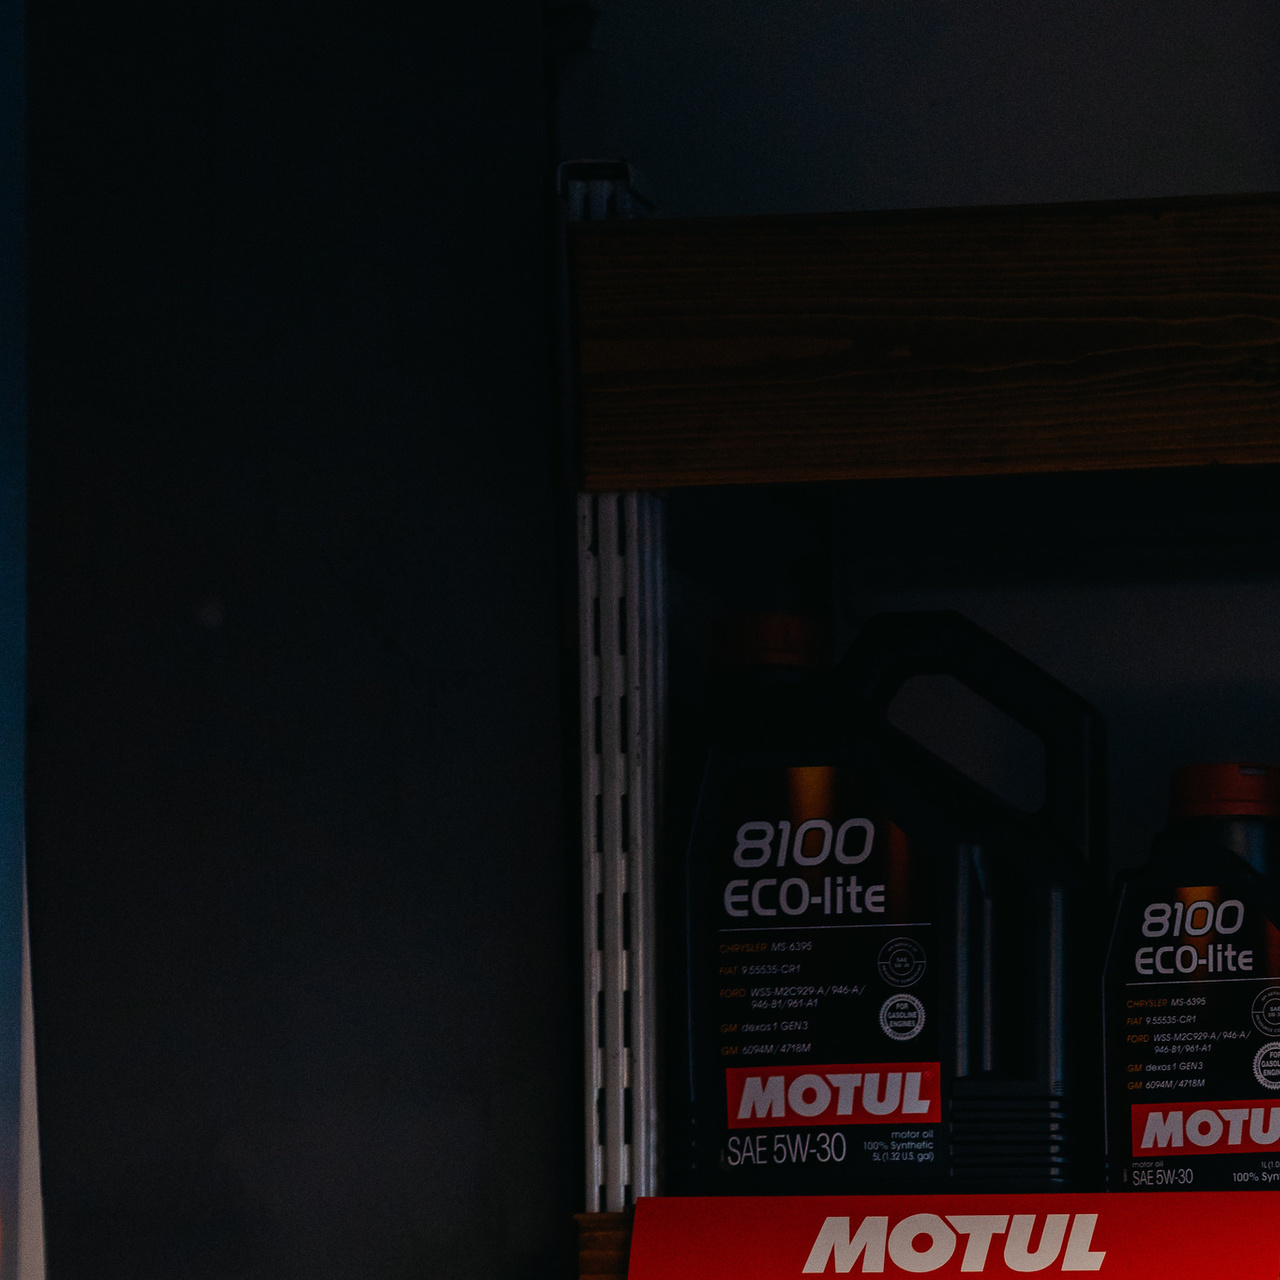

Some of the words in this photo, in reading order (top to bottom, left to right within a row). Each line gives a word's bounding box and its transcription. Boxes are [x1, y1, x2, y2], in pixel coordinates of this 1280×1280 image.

[733, 818, 875, 868] 8100
[724, 875, 886, 917] ECO-lite
[1142, 900, 1244, 938] 8100
[1135, 944, 1253, 974] ECO-lite
[1124, 1000, 1168, 1008] CHRYSLER
[1171, 998, 1206, 1006] MS-6395
[737, 1072, 932, 1120] MOTUL
[727, 1136, 768, 1166] SAE
[773, 1132, 846, 1163] 5W-30
[1132, 1170, 1154, 1186] SAE
[1156, 1168, 1194, 1184] 5W-30
[802, 1213, 1107, 1274] MOTUL
